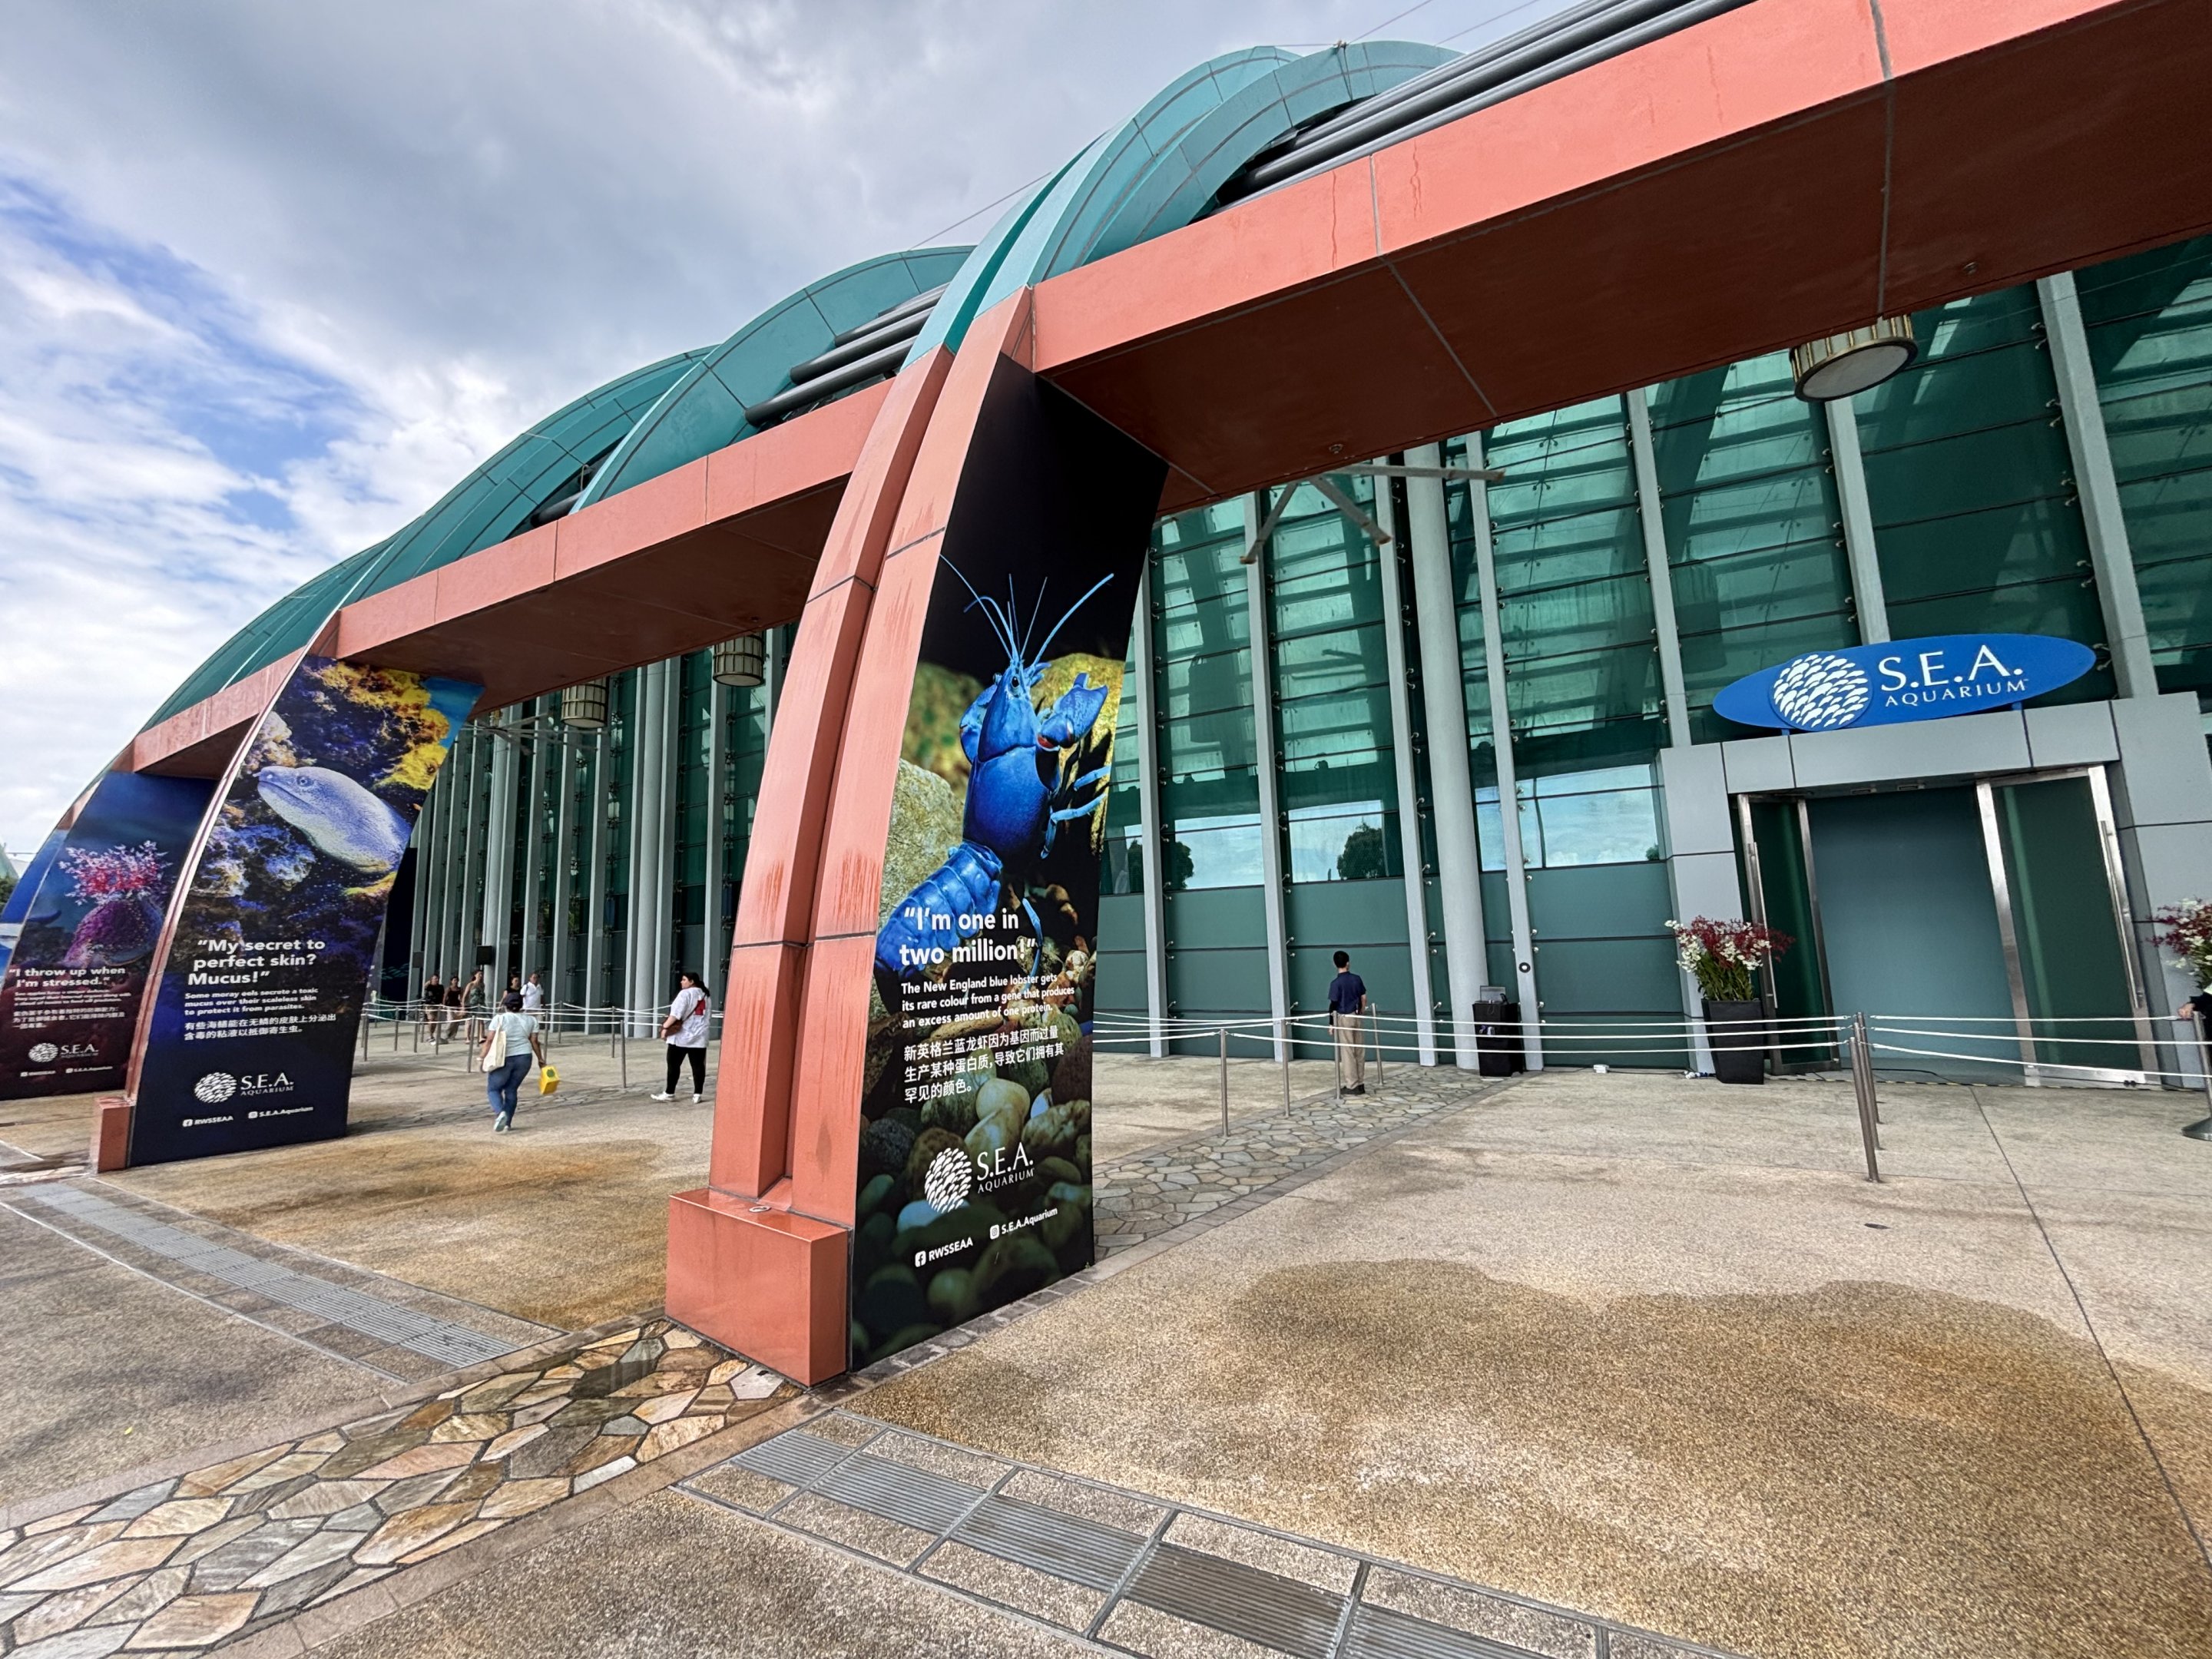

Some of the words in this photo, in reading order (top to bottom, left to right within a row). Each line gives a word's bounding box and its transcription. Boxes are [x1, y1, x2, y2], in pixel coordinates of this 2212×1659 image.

[1878, 644, 2024, 691] S.E.A.
[1885, 679, 2026, 707] AQUARIUM
[959, 913, 995, 929] one
[1002, 909, 1018, 929] in
[244, 939, 302, 950] secret
[306, 939, 326, 950] to
[899, 945, 945, 965] two
[952, 938, 1035, 964] million!”
[25, 968, 65, 976] throw
[90, 966, 126, 975] when
[194, 955, 265, 972] perfect
[270, 954, 317, 966] skin?
[901, 982, 920, 995] The
[923, 981, 946, 993] New
[949, 977, 987, 992] England
[989, 975, 1008, 987] blue
[1010, 974, 1038, 985] lobster
[1041, 973, 1058, 985] gets
[197, 1007, 231, 1016] protect
[902, 1000, 915, 1012] its
[917, 999, 937, 1010] rare
[940, 996, 969, 1008] colour
[971, 993, 992, 1005] from
[1002, 992, 1022, 1004] gene
[1024, 989, 1040, 999] that
[1041, 985, 1075, 1000] produces
[902, 1019, 915, 1028] an
[919, 1015, 952, 1027] excess
[955, 1009, 989, 1022] amount
[992, 1006, 1002, 1018] of
[1003, 1007, 1020, 1017] one
[1022, 1002, 1053, 1016] protein.
[61, 1044, 99, 1055] S.E.A.
[904, 1025, 1058, 1061] 新英格兰蓝龙虾因为基因而过量
[240, 1072, 294, 1090] S.E.A.
[240, 1085, 294, 1096] AQUARIUM
[905, 1078, 972, 1104] 罕见的颜色。
[977, 1141, 1034, 1181] S.E.A.
[978, 1168, 1034, 1194] AQUARIUM
[929, 1237, 973, 1262] RWSSEAA
[1001, 1207, 1058, 1234] S.E.A.Aquarium
